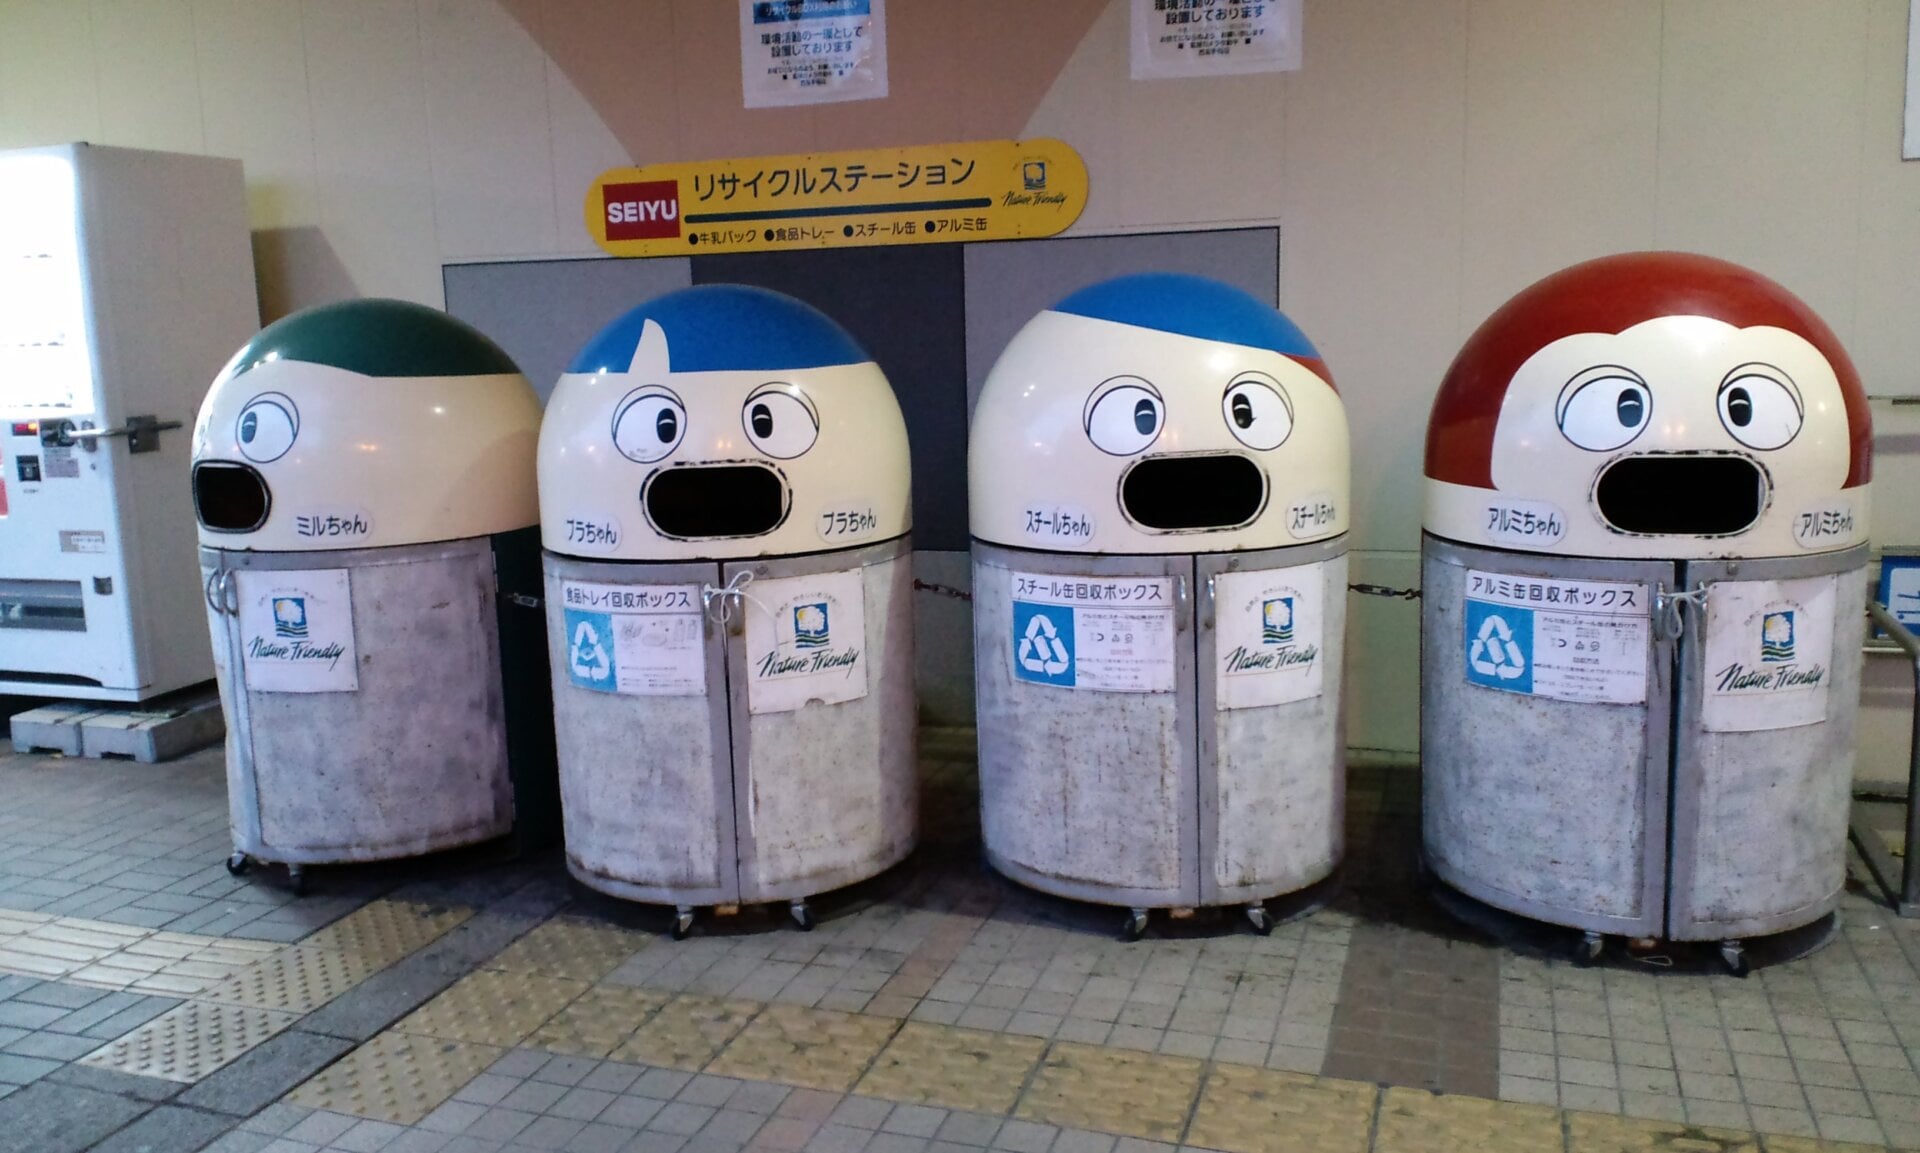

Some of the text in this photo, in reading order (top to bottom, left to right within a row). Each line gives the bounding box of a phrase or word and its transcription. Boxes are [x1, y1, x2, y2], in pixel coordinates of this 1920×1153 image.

[1165, 5, 1265, 25] 設置しております
[761, 26, 863, 45] 環境活動の一環として
[771, 40, 853, 58] 設置しております
[694, 158, 976, 202] リサイクルステーション
[607, 199, 678, 224] SEIYU
[776, 226, 835, 243] 食品トレー
[855, 221, 916, 238] スチール缶
[937, 217, 988, 234] アルミ缶
[297, 514, 368, 537] ミルちゃん
[1025, 509, 1091, 537] スチールちゃん
[1487, 506, 1561, 537] アルミちゃん
[1800, 508, 1853, 538] アルミちゃん
[565, 586, 692, 608] 食品トレイ回収ボックス
[1017, 577, 1163, 601] スチール缶回収ボックス
[1472, 576, 1637, 608] アルミ缶回収ボックス
[248, 635, 345, 672] Nature Friendly
[756, 646, 860, 679] Nature Friendly
[1224, 643, 1319, 678] Nature Friendly
[1715, 662, 1825, 694] Nature Friendly
